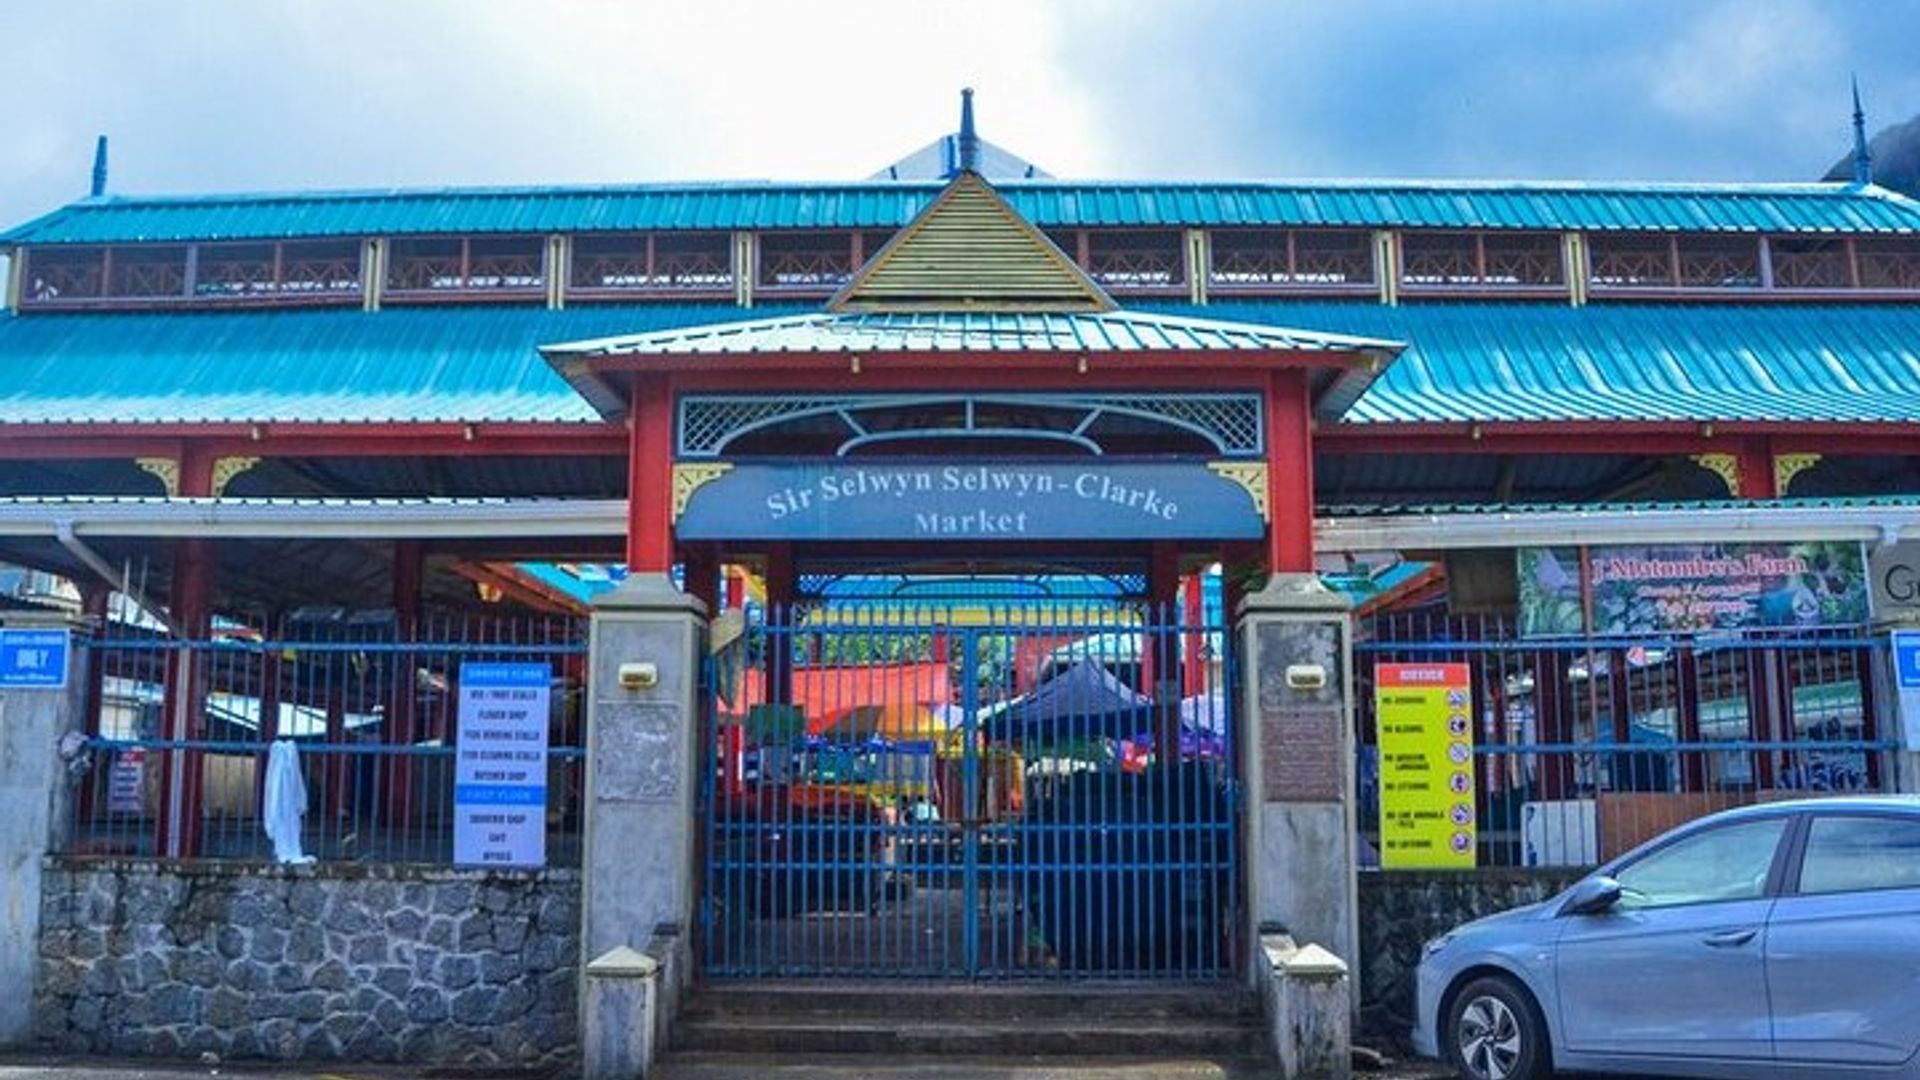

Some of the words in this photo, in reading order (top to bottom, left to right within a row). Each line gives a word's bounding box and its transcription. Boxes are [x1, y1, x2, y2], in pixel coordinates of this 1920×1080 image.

[767, 487, 813, 520] Sir
[820, 468, 932, 500] Selwyn
[942, 465, 1179, 521] Selwyn-Clarke
[915, 509, 1028, 534] Market
